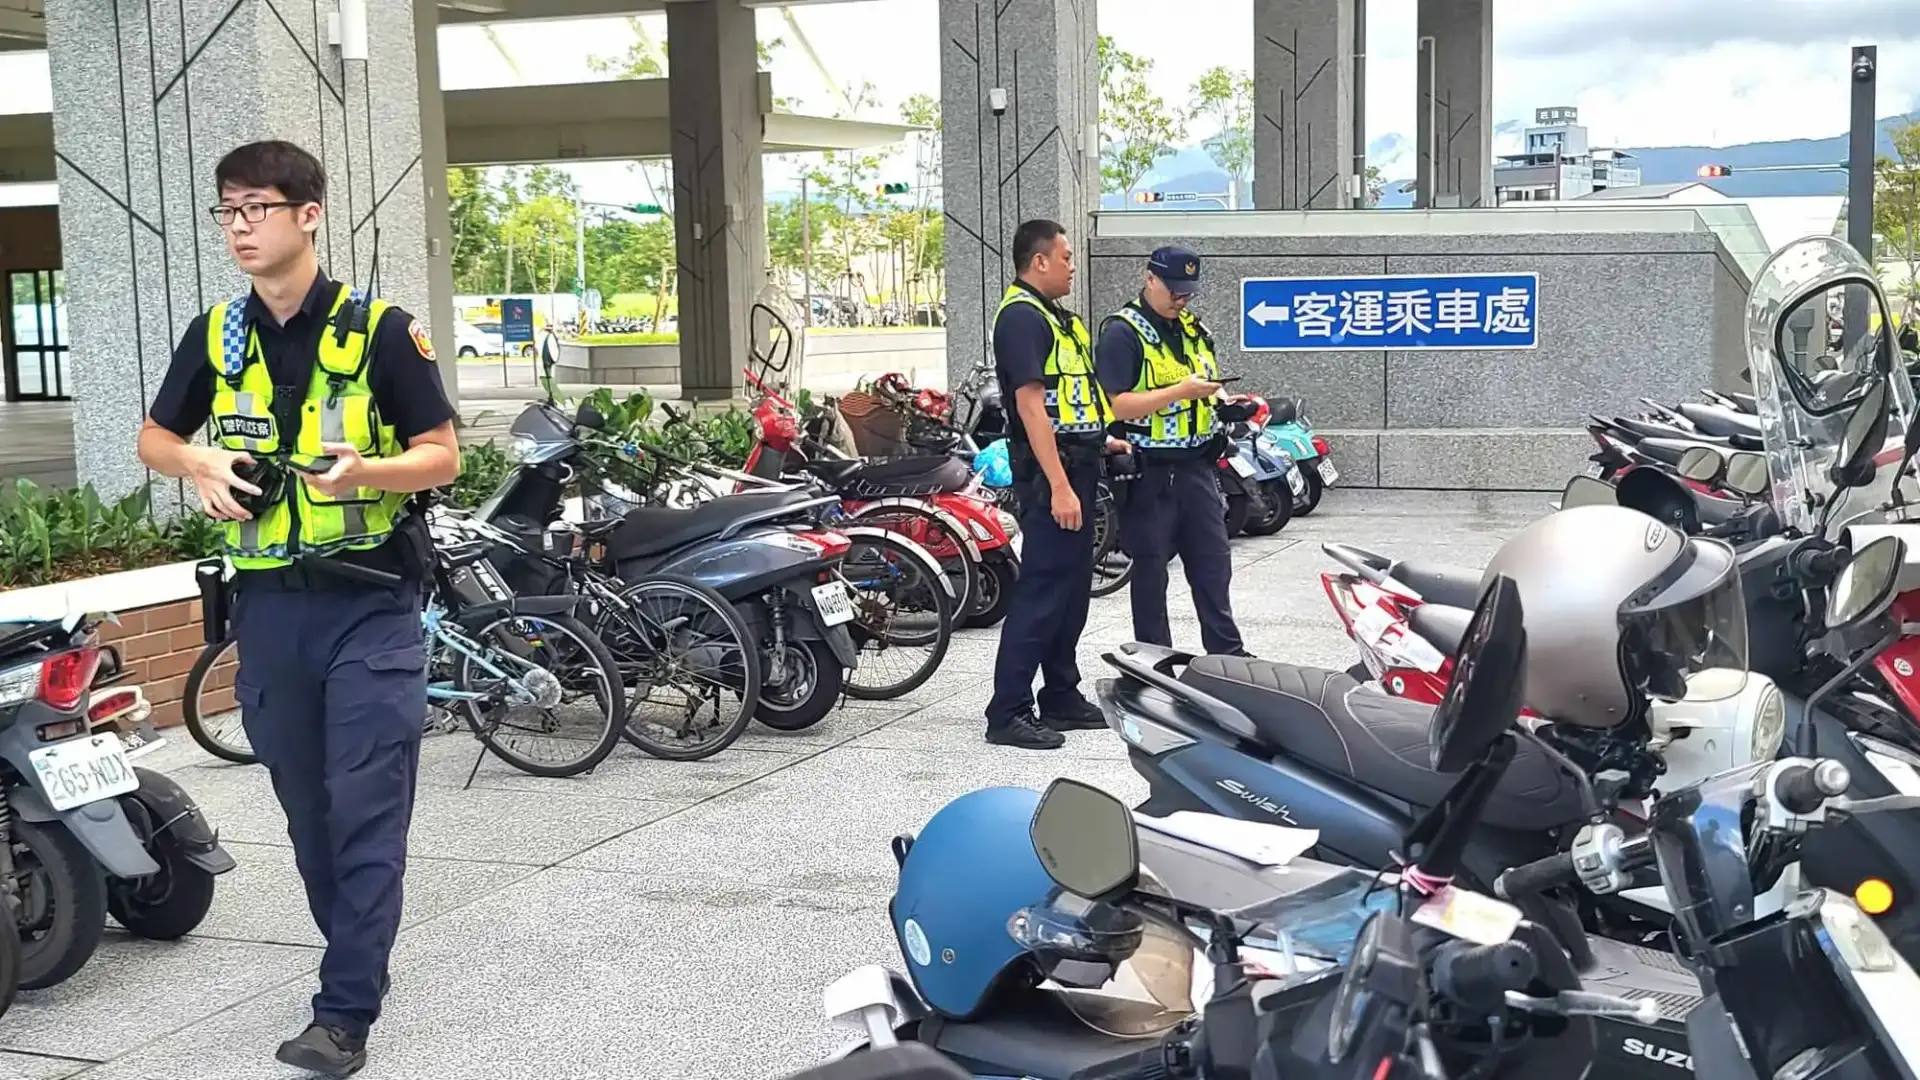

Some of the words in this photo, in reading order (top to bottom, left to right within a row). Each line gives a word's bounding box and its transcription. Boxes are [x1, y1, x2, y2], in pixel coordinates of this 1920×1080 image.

[1293, 286, 1531, 338] 客運乘車處
[1215, 779, 1298, 825] Swish
